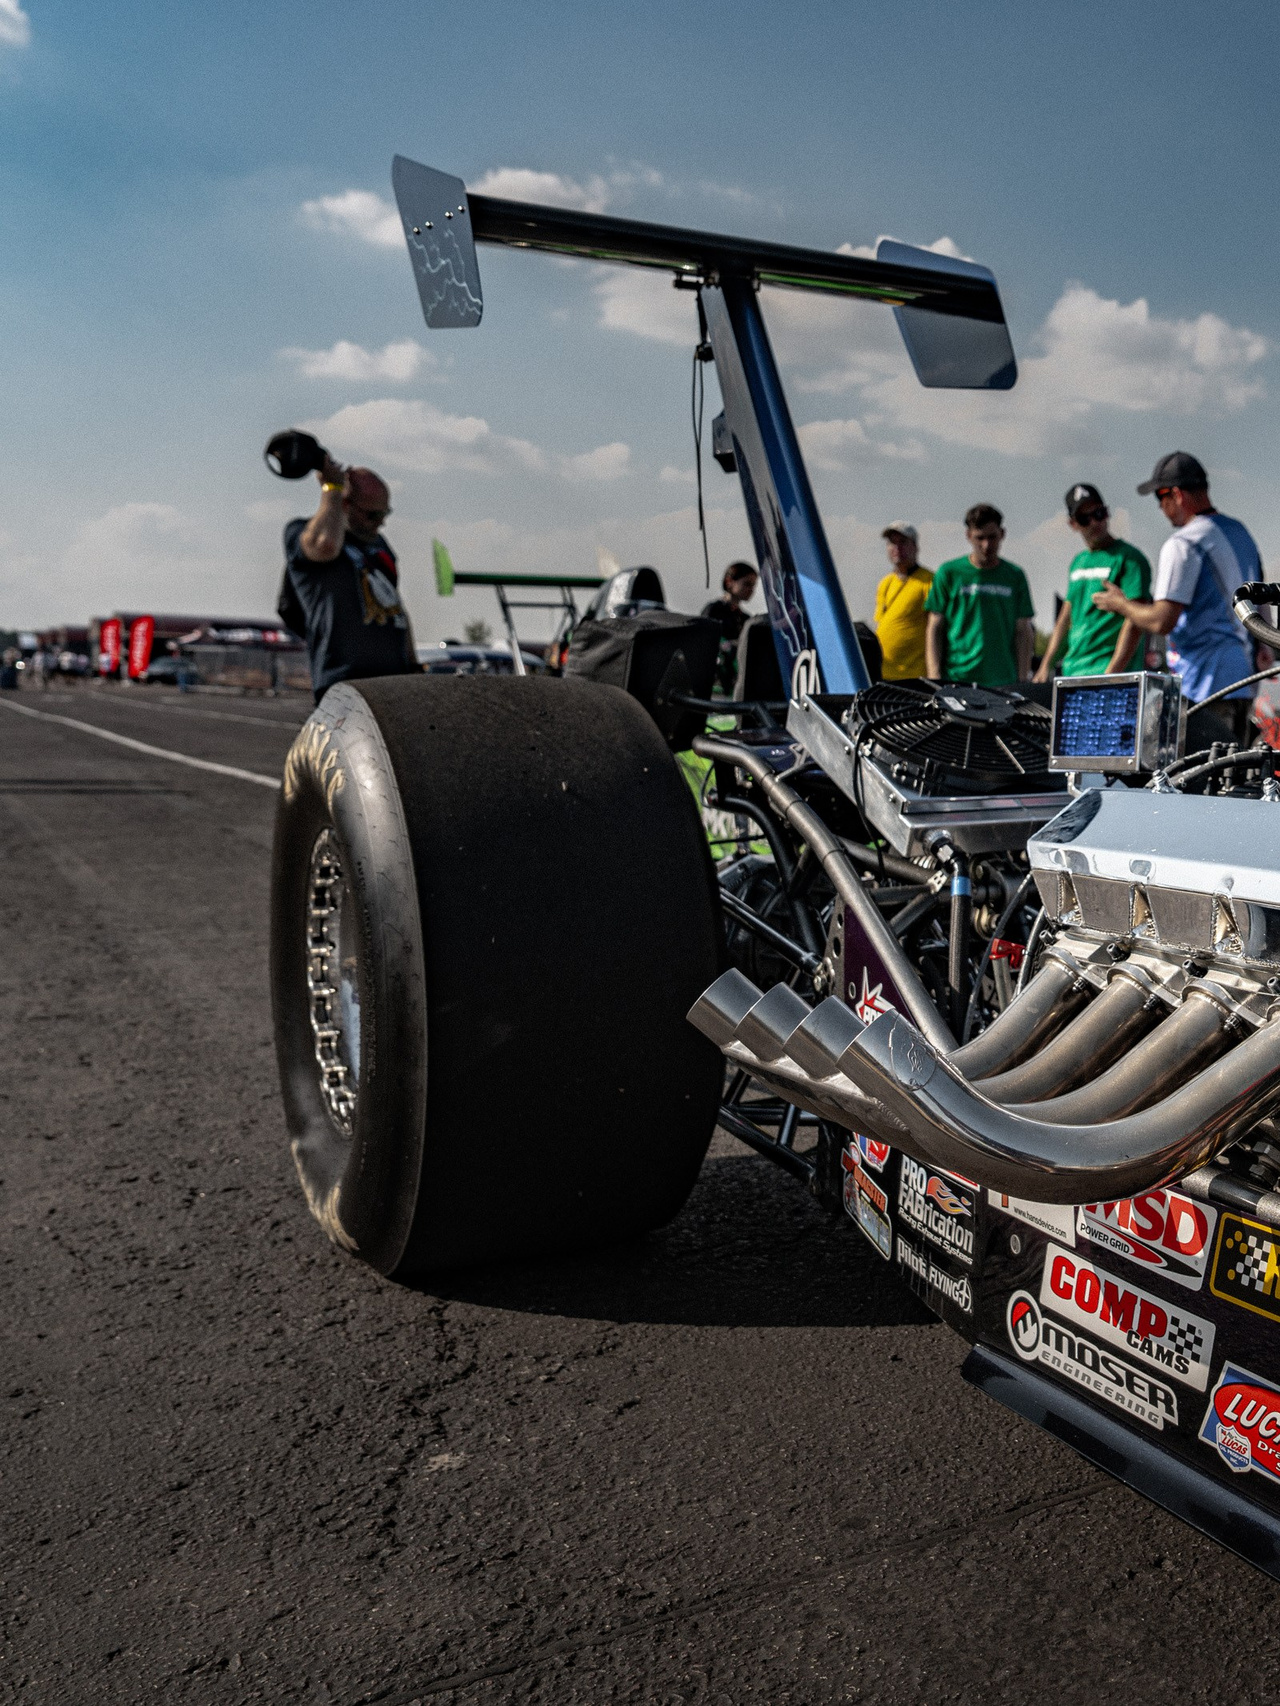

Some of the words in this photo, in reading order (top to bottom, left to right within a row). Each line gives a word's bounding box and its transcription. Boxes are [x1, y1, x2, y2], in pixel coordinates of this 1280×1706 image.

[901, 1154, 927, 1195] PRO
[899, 1184, 974, 1254] FABrication
[1013, 1205, 1068, 1239] www.hansdevice.com
[1080, 1223, 1109, 1245] POWER
[1109, 1236, 1130, 1254] GRID
[942, 1240, 973, 1265] Systems
[929, 1265, 960, 1302] FLYING
[1050, 1255, 1168, 1341] COMP
[1042, 1323, 1175, 1417] MOSER
[1126, 1329, 1190, 1375] CAMS
[1042, 1351, 1159, 1425] ENGINEERING
[1221, 1436, 1248, 1455] LUCAS
